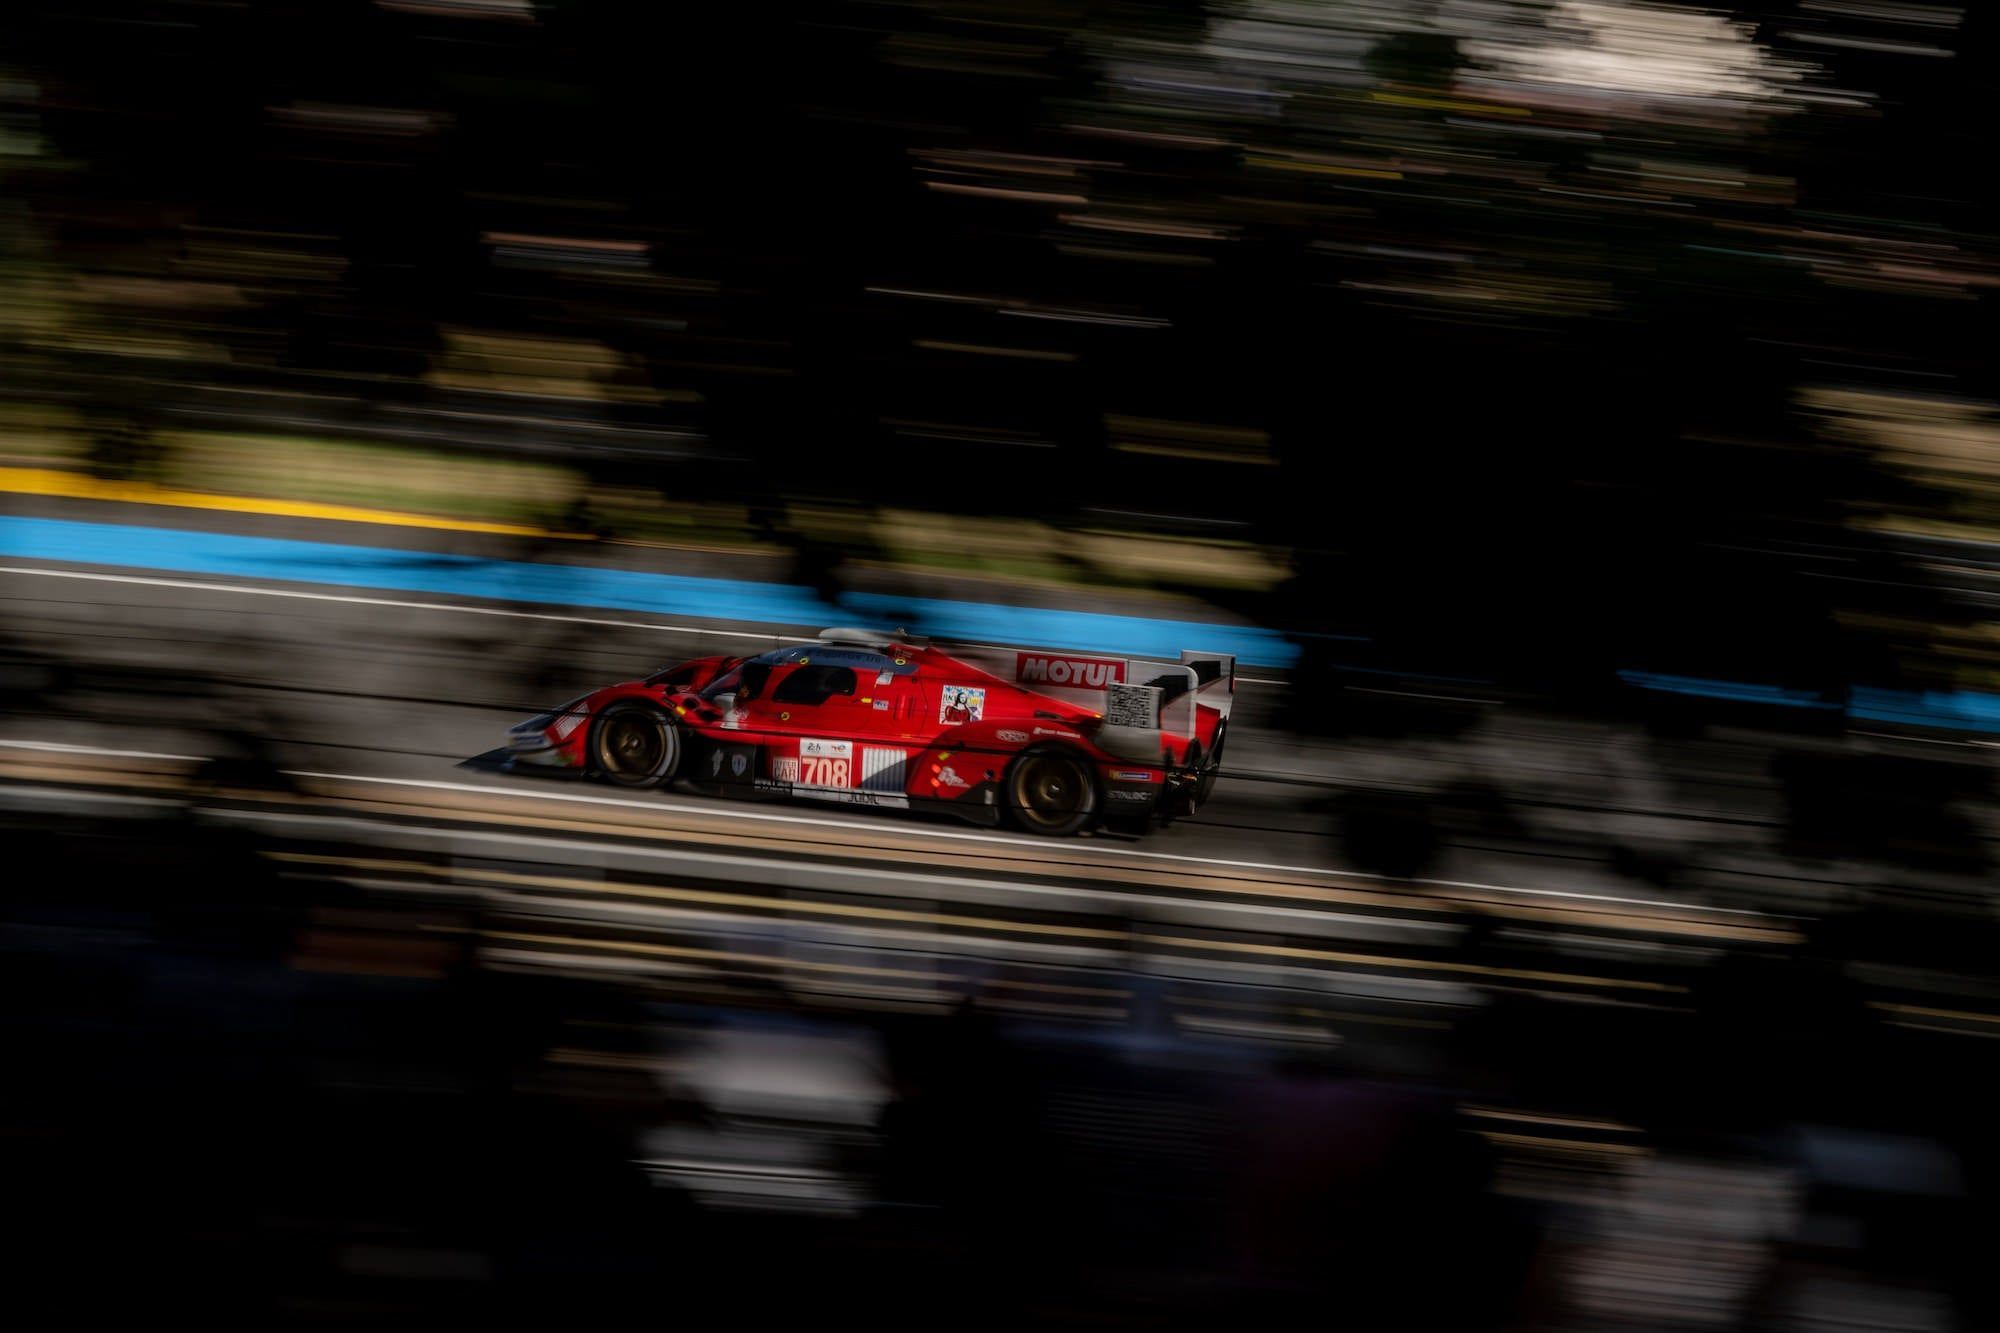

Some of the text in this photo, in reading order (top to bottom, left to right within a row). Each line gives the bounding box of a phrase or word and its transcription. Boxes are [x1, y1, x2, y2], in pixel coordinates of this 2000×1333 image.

[1022, 657, 1120, 687] MOTUL
[774, 767, 797, 780] CAR
[801, 757, 848, 788] 708
